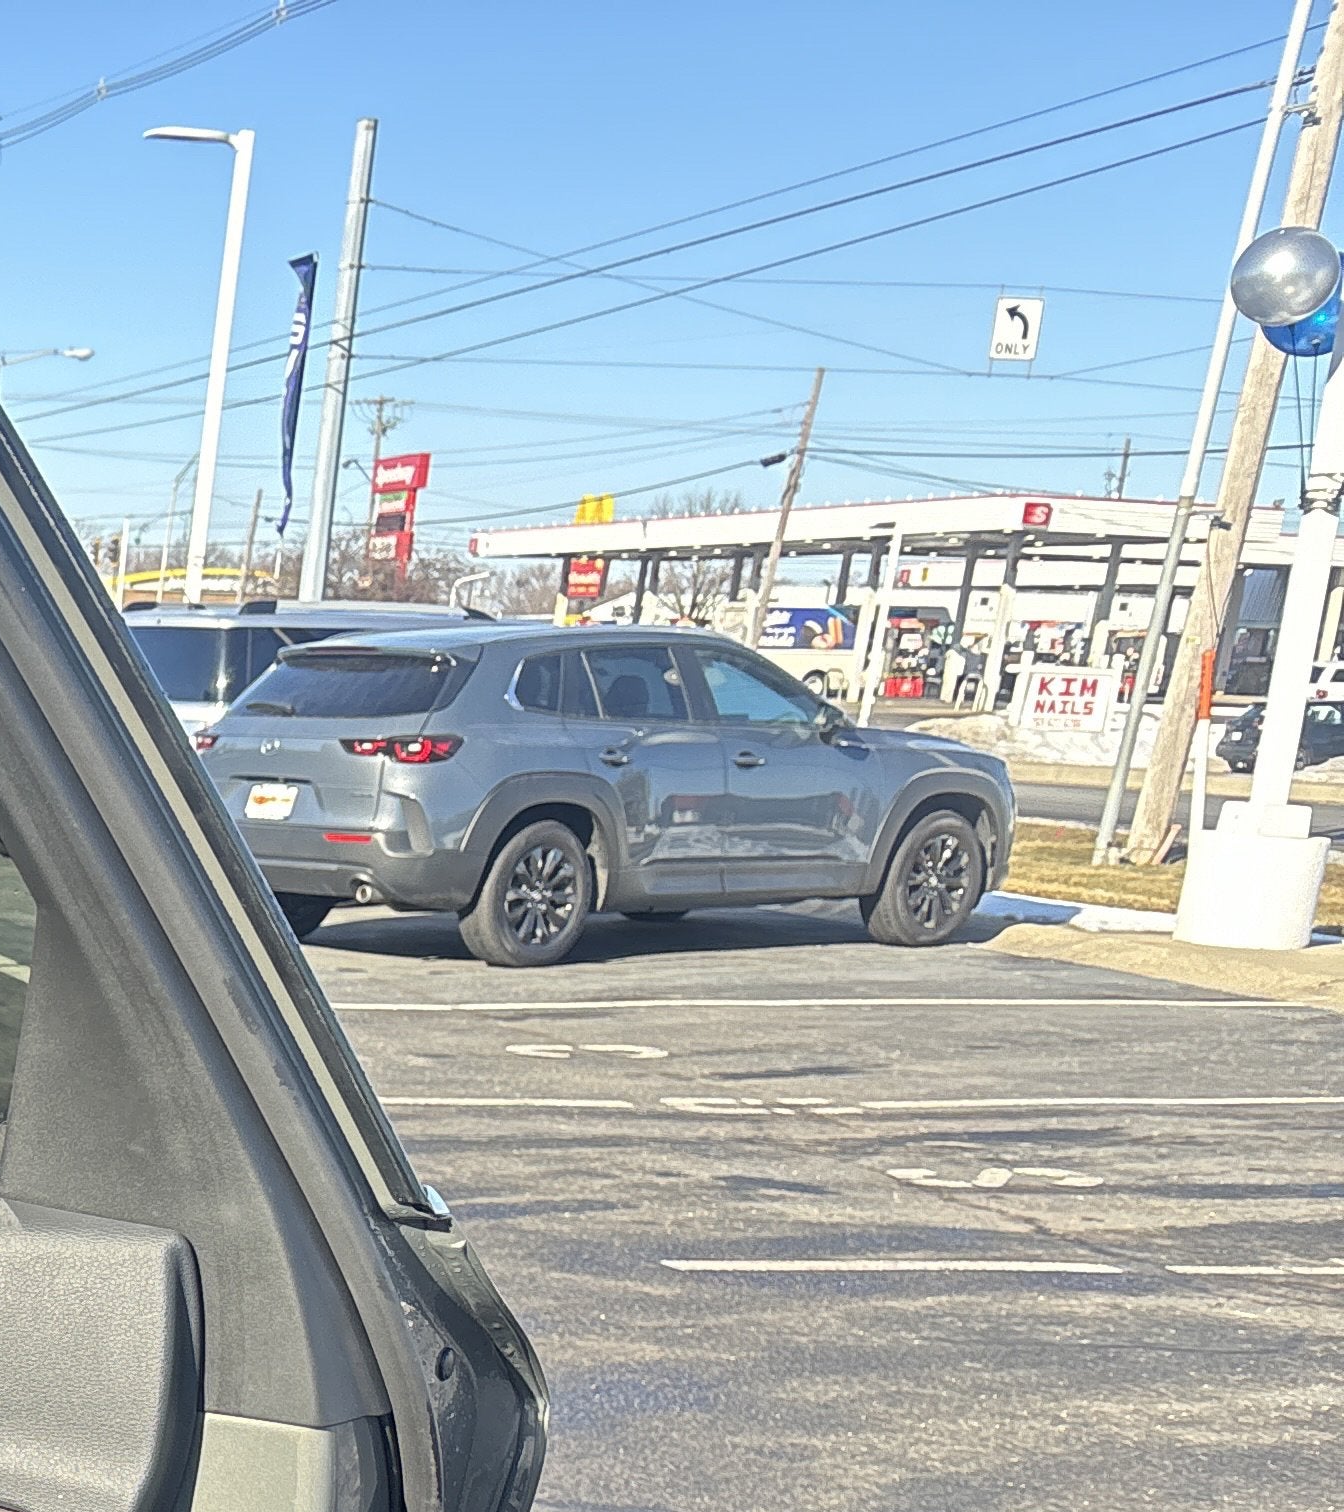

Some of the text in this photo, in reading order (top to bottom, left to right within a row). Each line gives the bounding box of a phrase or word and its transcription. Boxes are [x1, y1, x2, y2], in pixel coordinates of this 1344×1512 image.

[995, 342, 1030, 355] ONLY
[1038, 676, 1098, 697] KIM
[1034, 700, 1095, 715] NAILS
